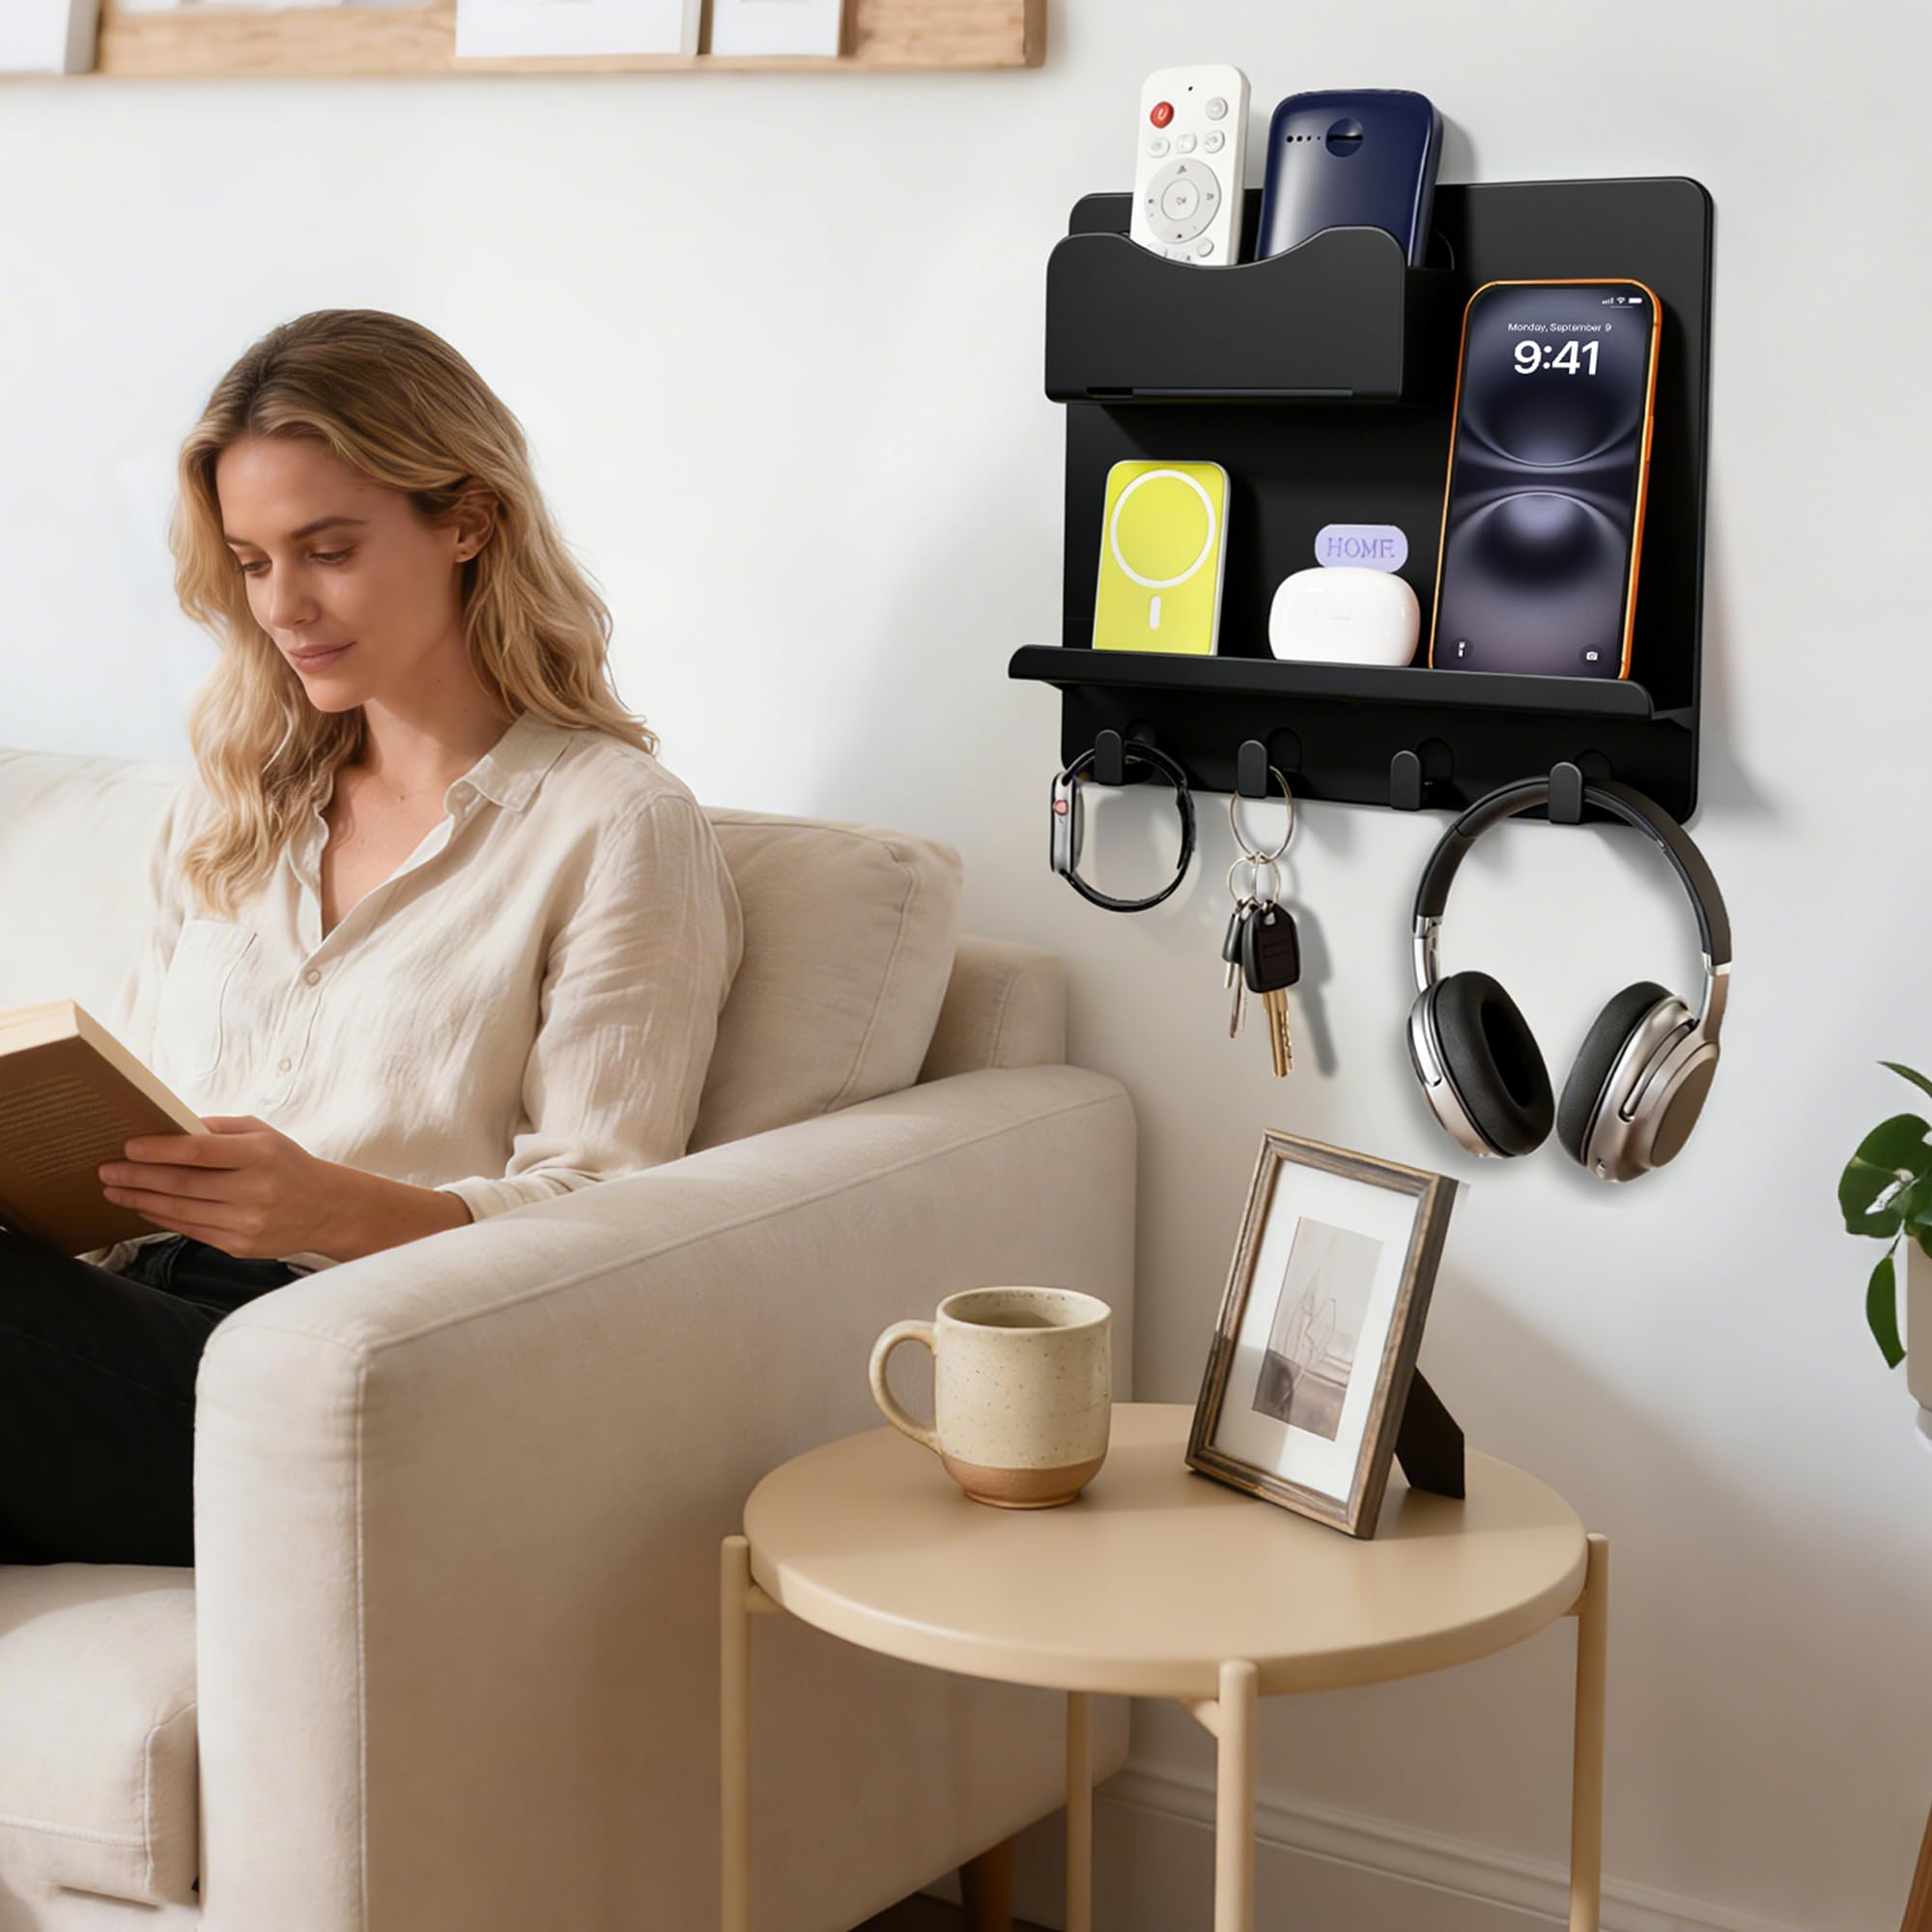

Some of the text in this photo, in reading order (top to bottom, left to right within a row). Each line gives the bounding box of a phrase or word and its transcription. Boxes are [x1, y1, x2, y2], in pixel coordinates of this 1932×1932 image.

[1507, 323, 1548, 333] Monday,
[1605, 323, 1612, 332] 9
[1514, 340, 1600, 375] 9:41
[1326, 537, 1396, 558] HOME
